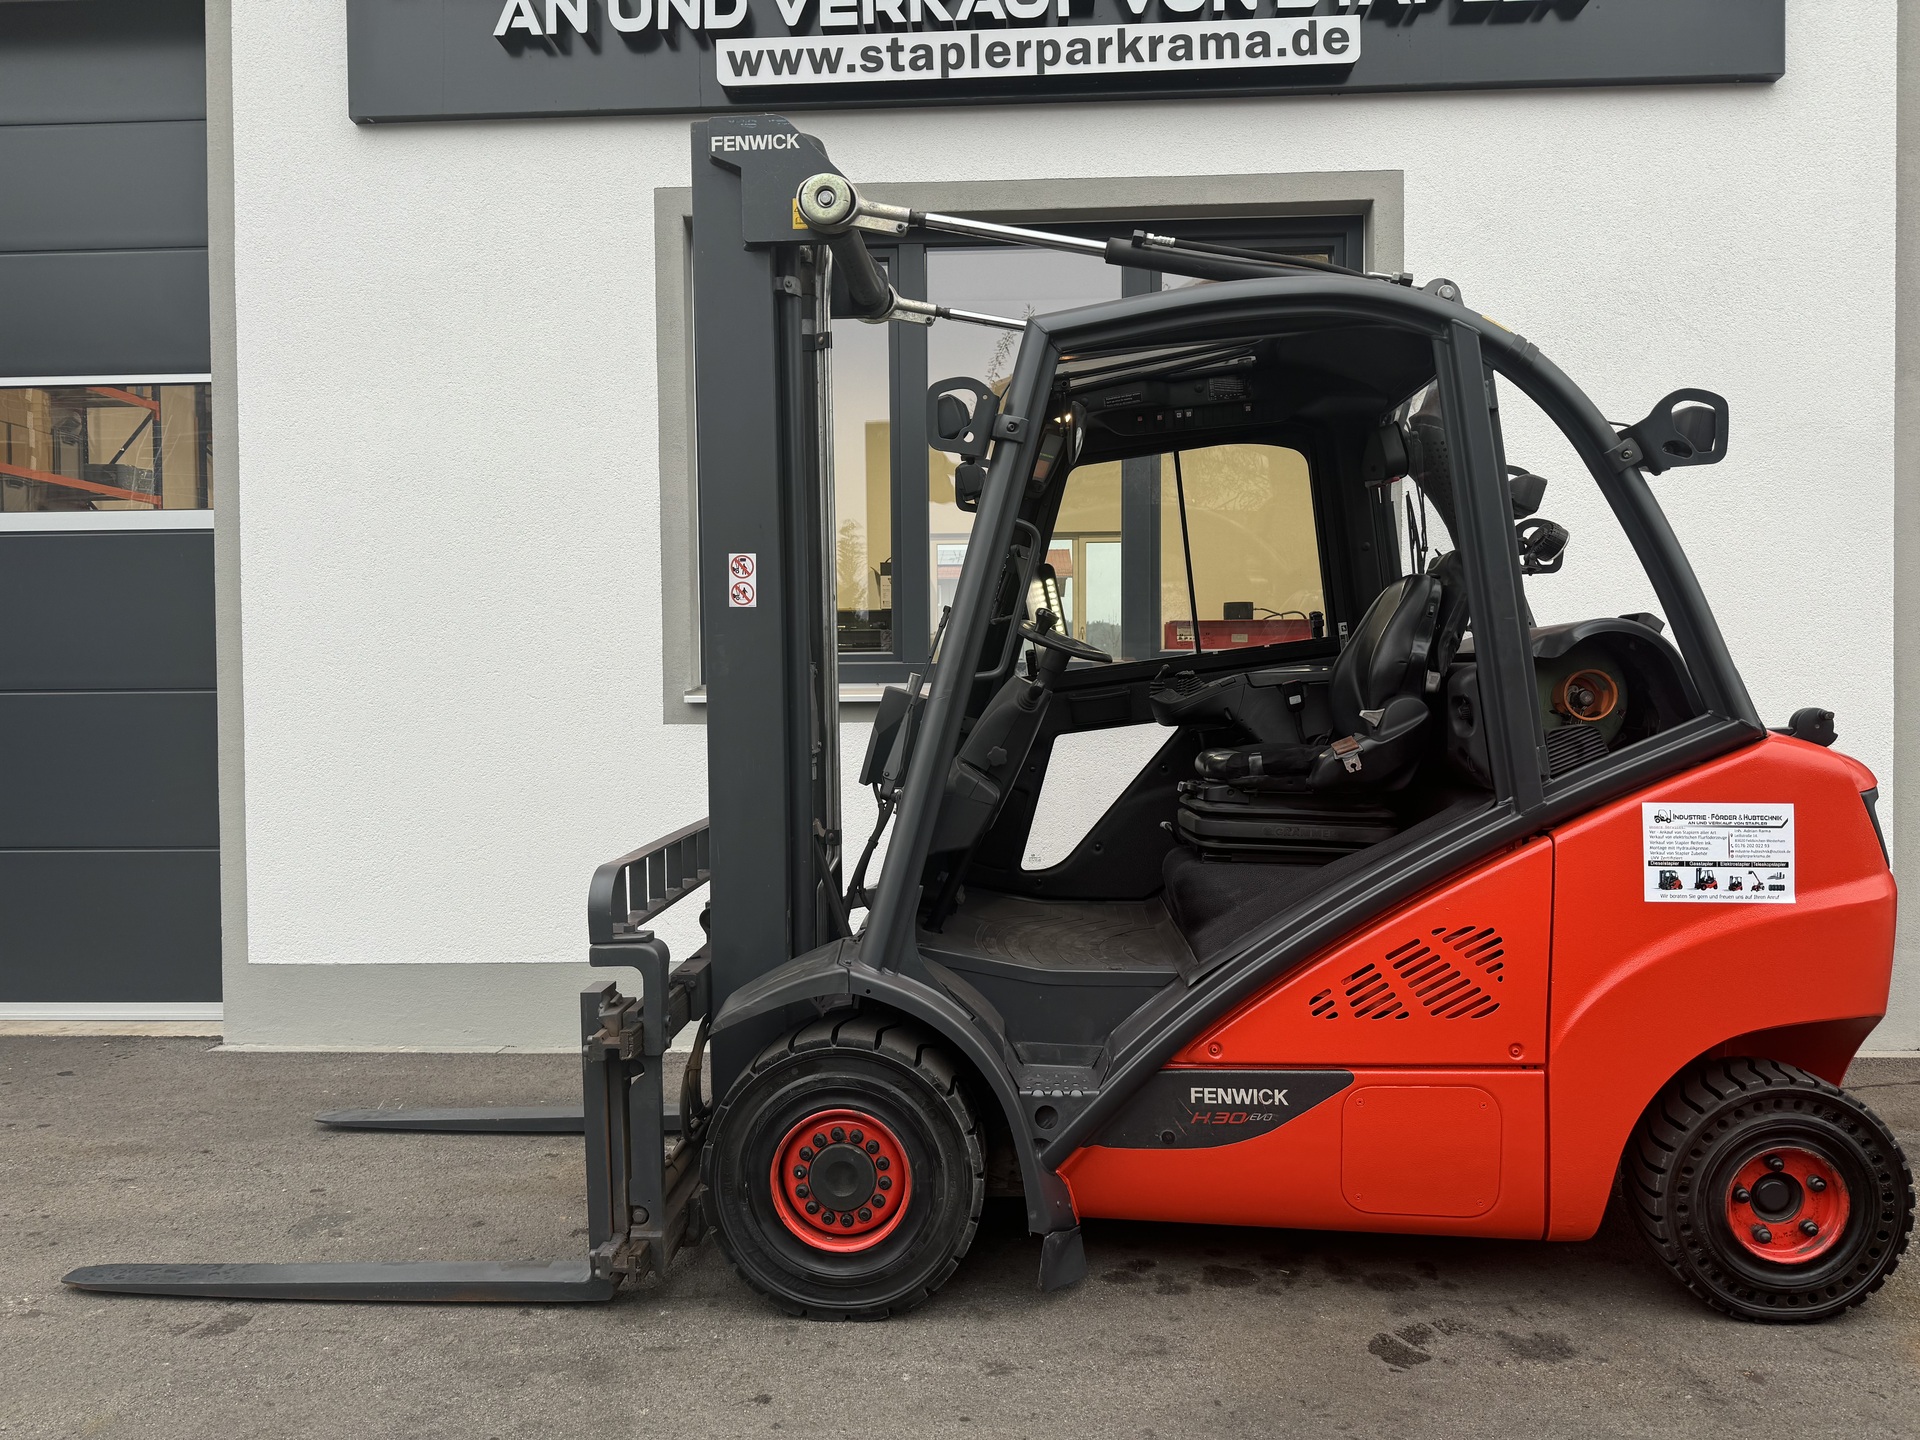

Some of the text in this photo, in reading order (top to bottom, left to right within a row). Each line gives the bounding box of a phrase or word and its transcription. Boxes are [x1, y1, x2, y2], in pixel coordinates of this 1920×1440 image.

[493, 0, 588, 35] AN
[726, 20, 1350, 78] www.staplerparkrama.de
[711, 133, 800, 152] FENWICK
[1190, 1088, 1289, 1106] FENWICK
